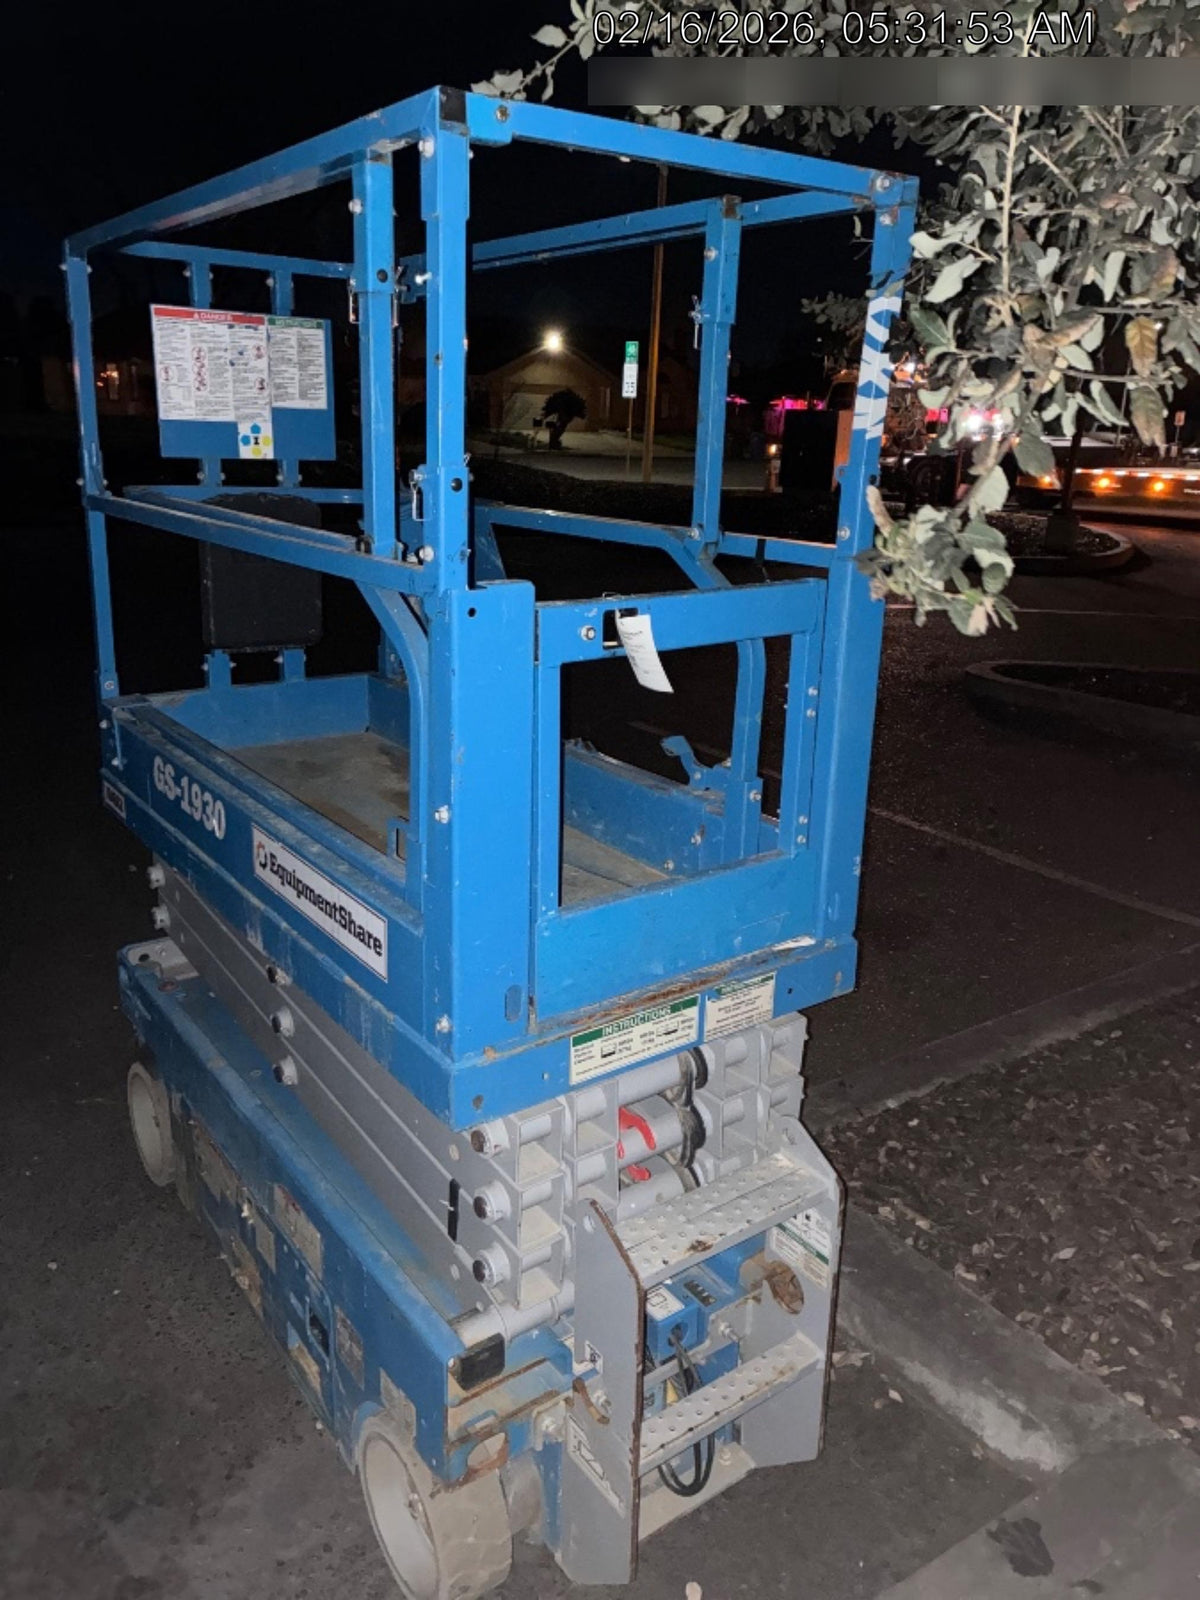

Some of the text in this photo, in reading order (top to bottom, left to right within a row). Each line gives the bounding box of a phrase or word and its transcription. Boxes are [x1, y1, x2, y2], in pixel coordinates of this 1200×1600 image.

[153, 755, 226, 840] GS-1930
[269, 852, 383, 958] EquipmentShare
[602, 1005, 672, 1037] INSTRUCTIONS
